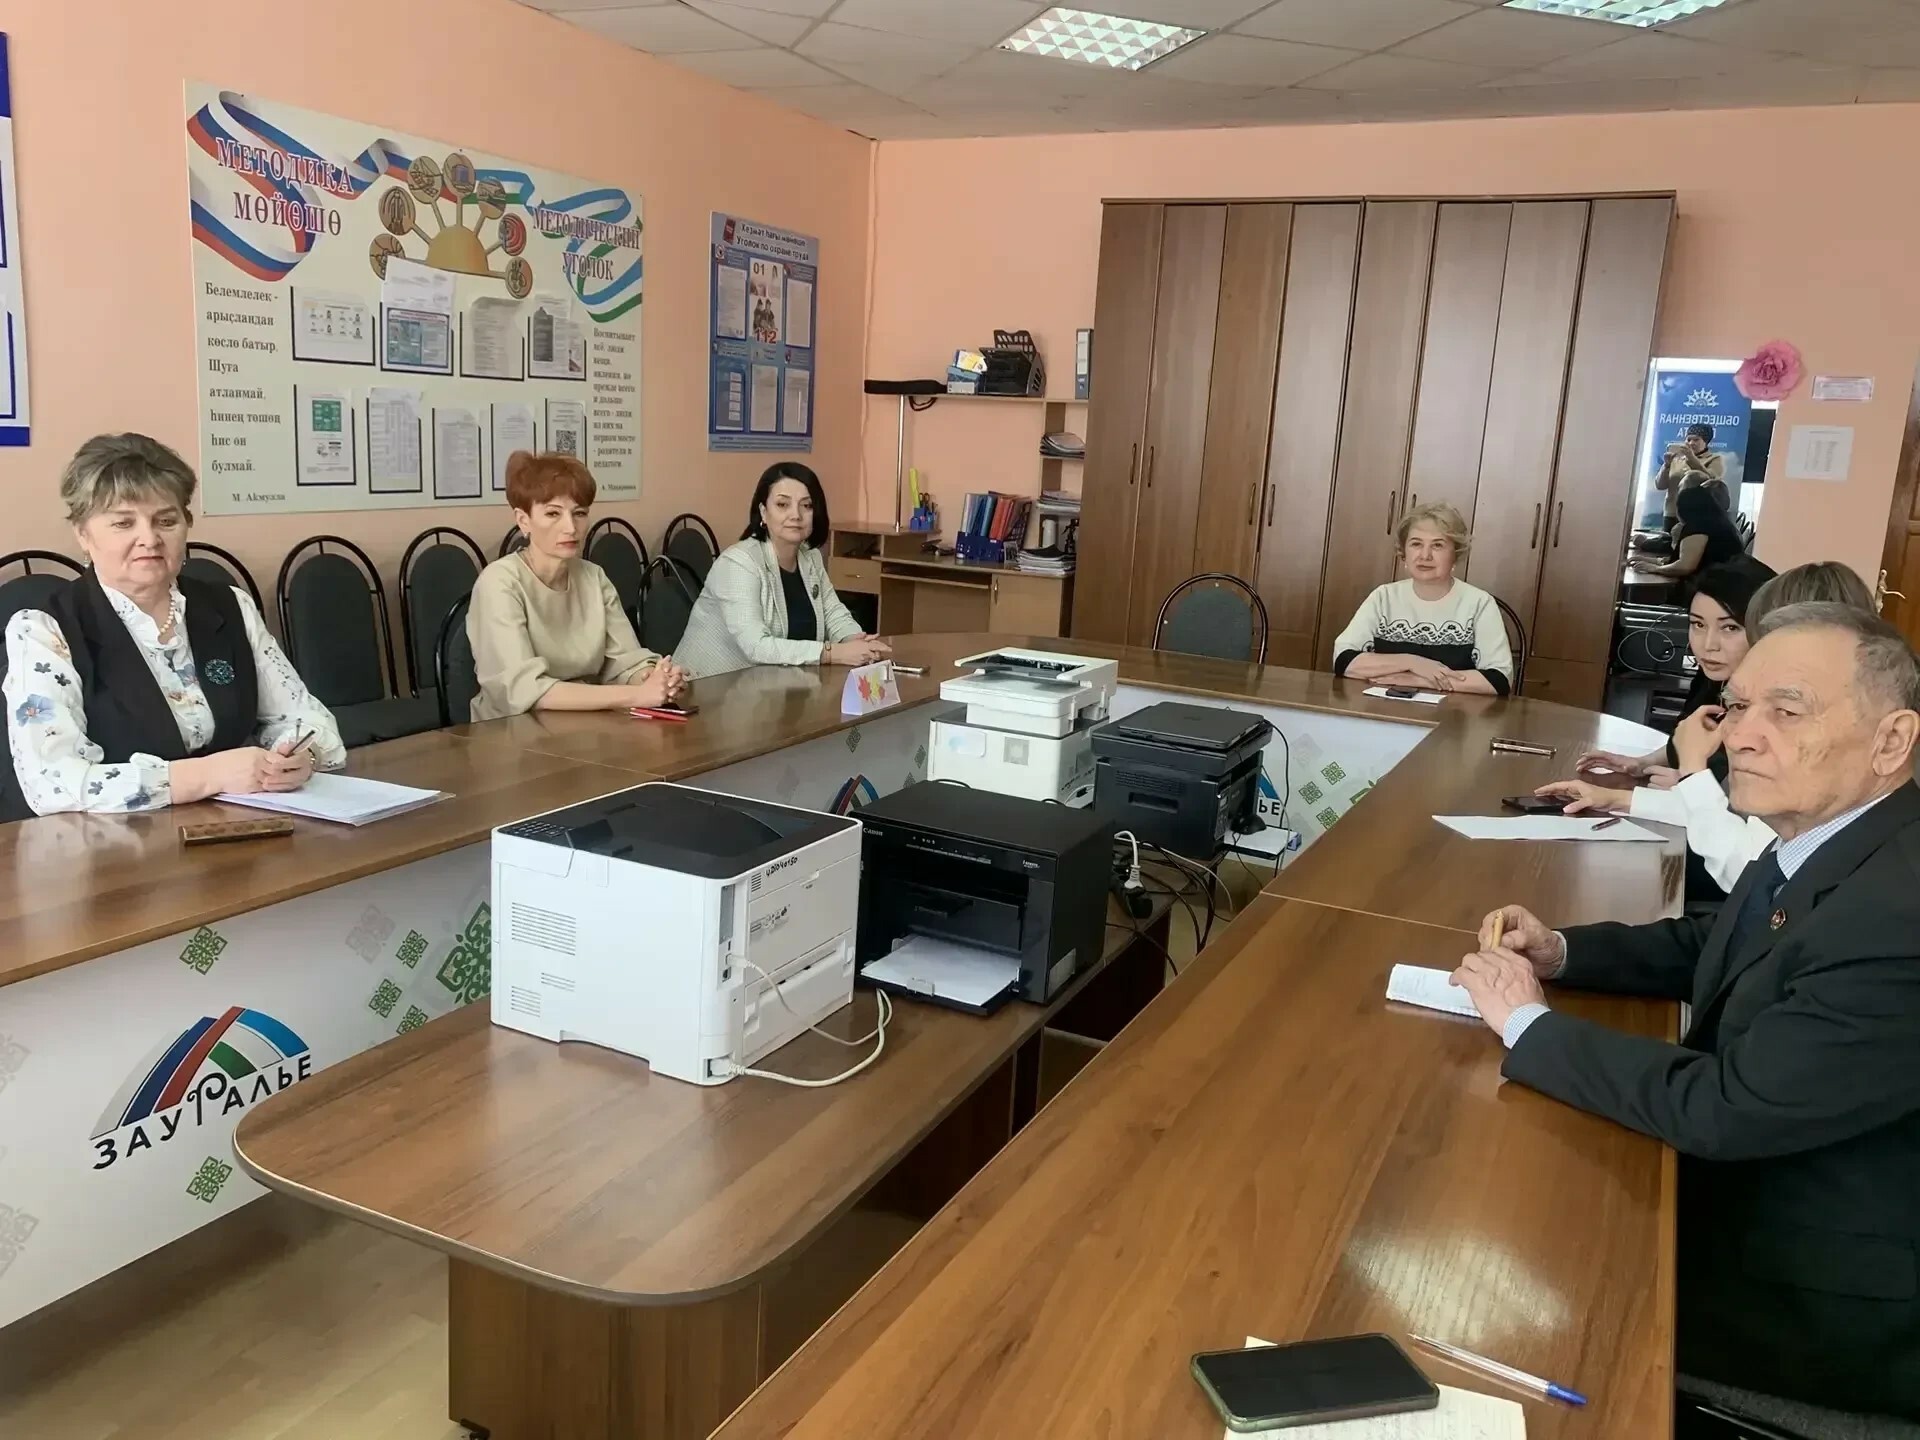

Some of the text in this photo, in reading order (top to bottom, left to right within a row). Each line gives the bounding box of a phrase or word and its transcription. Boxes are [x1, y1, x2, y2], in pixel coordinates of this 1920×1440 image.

[216, 138, 354, 194] МЕТОДИКА
[233, 191, 342, 236] МӨЙӨШӨ
[562, 252, 613, 280] УГОЛОК
[753, 262, 765, 275] 01
[205, 282, 272, 301] Белемлелек
[755, 328, 778, 344] 112
[93, 1054, 312, 1170] ЗАУРАЛЬЕ
